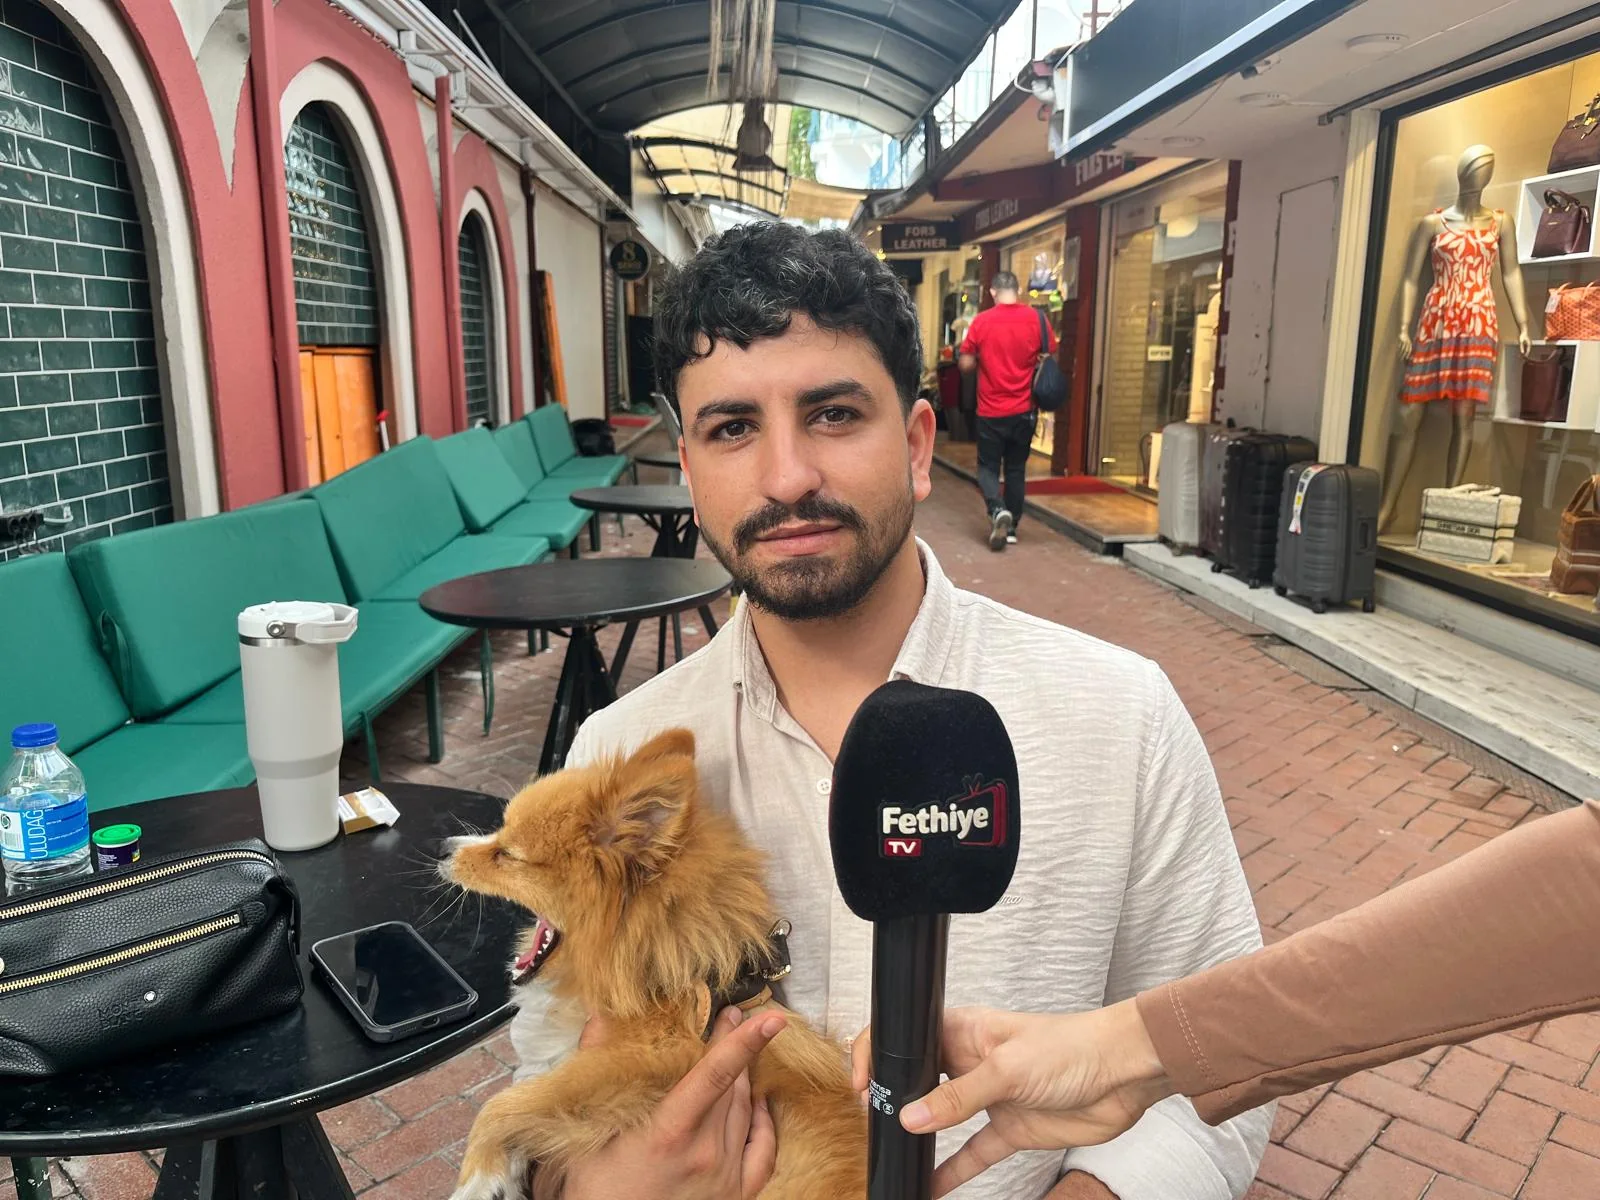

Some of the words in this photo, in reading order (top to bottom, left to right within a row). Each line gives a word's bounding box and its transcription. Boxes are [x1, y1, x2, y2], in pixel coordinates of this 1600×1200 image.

[904, 225, 936, 237] FORS
[894, 238, 947, 250] LEATHER
[881, 803, 989, 840] Fethiye
[22, 809, 48, 859] ULUDAĞ
[888, 840, 917, 854] TV
